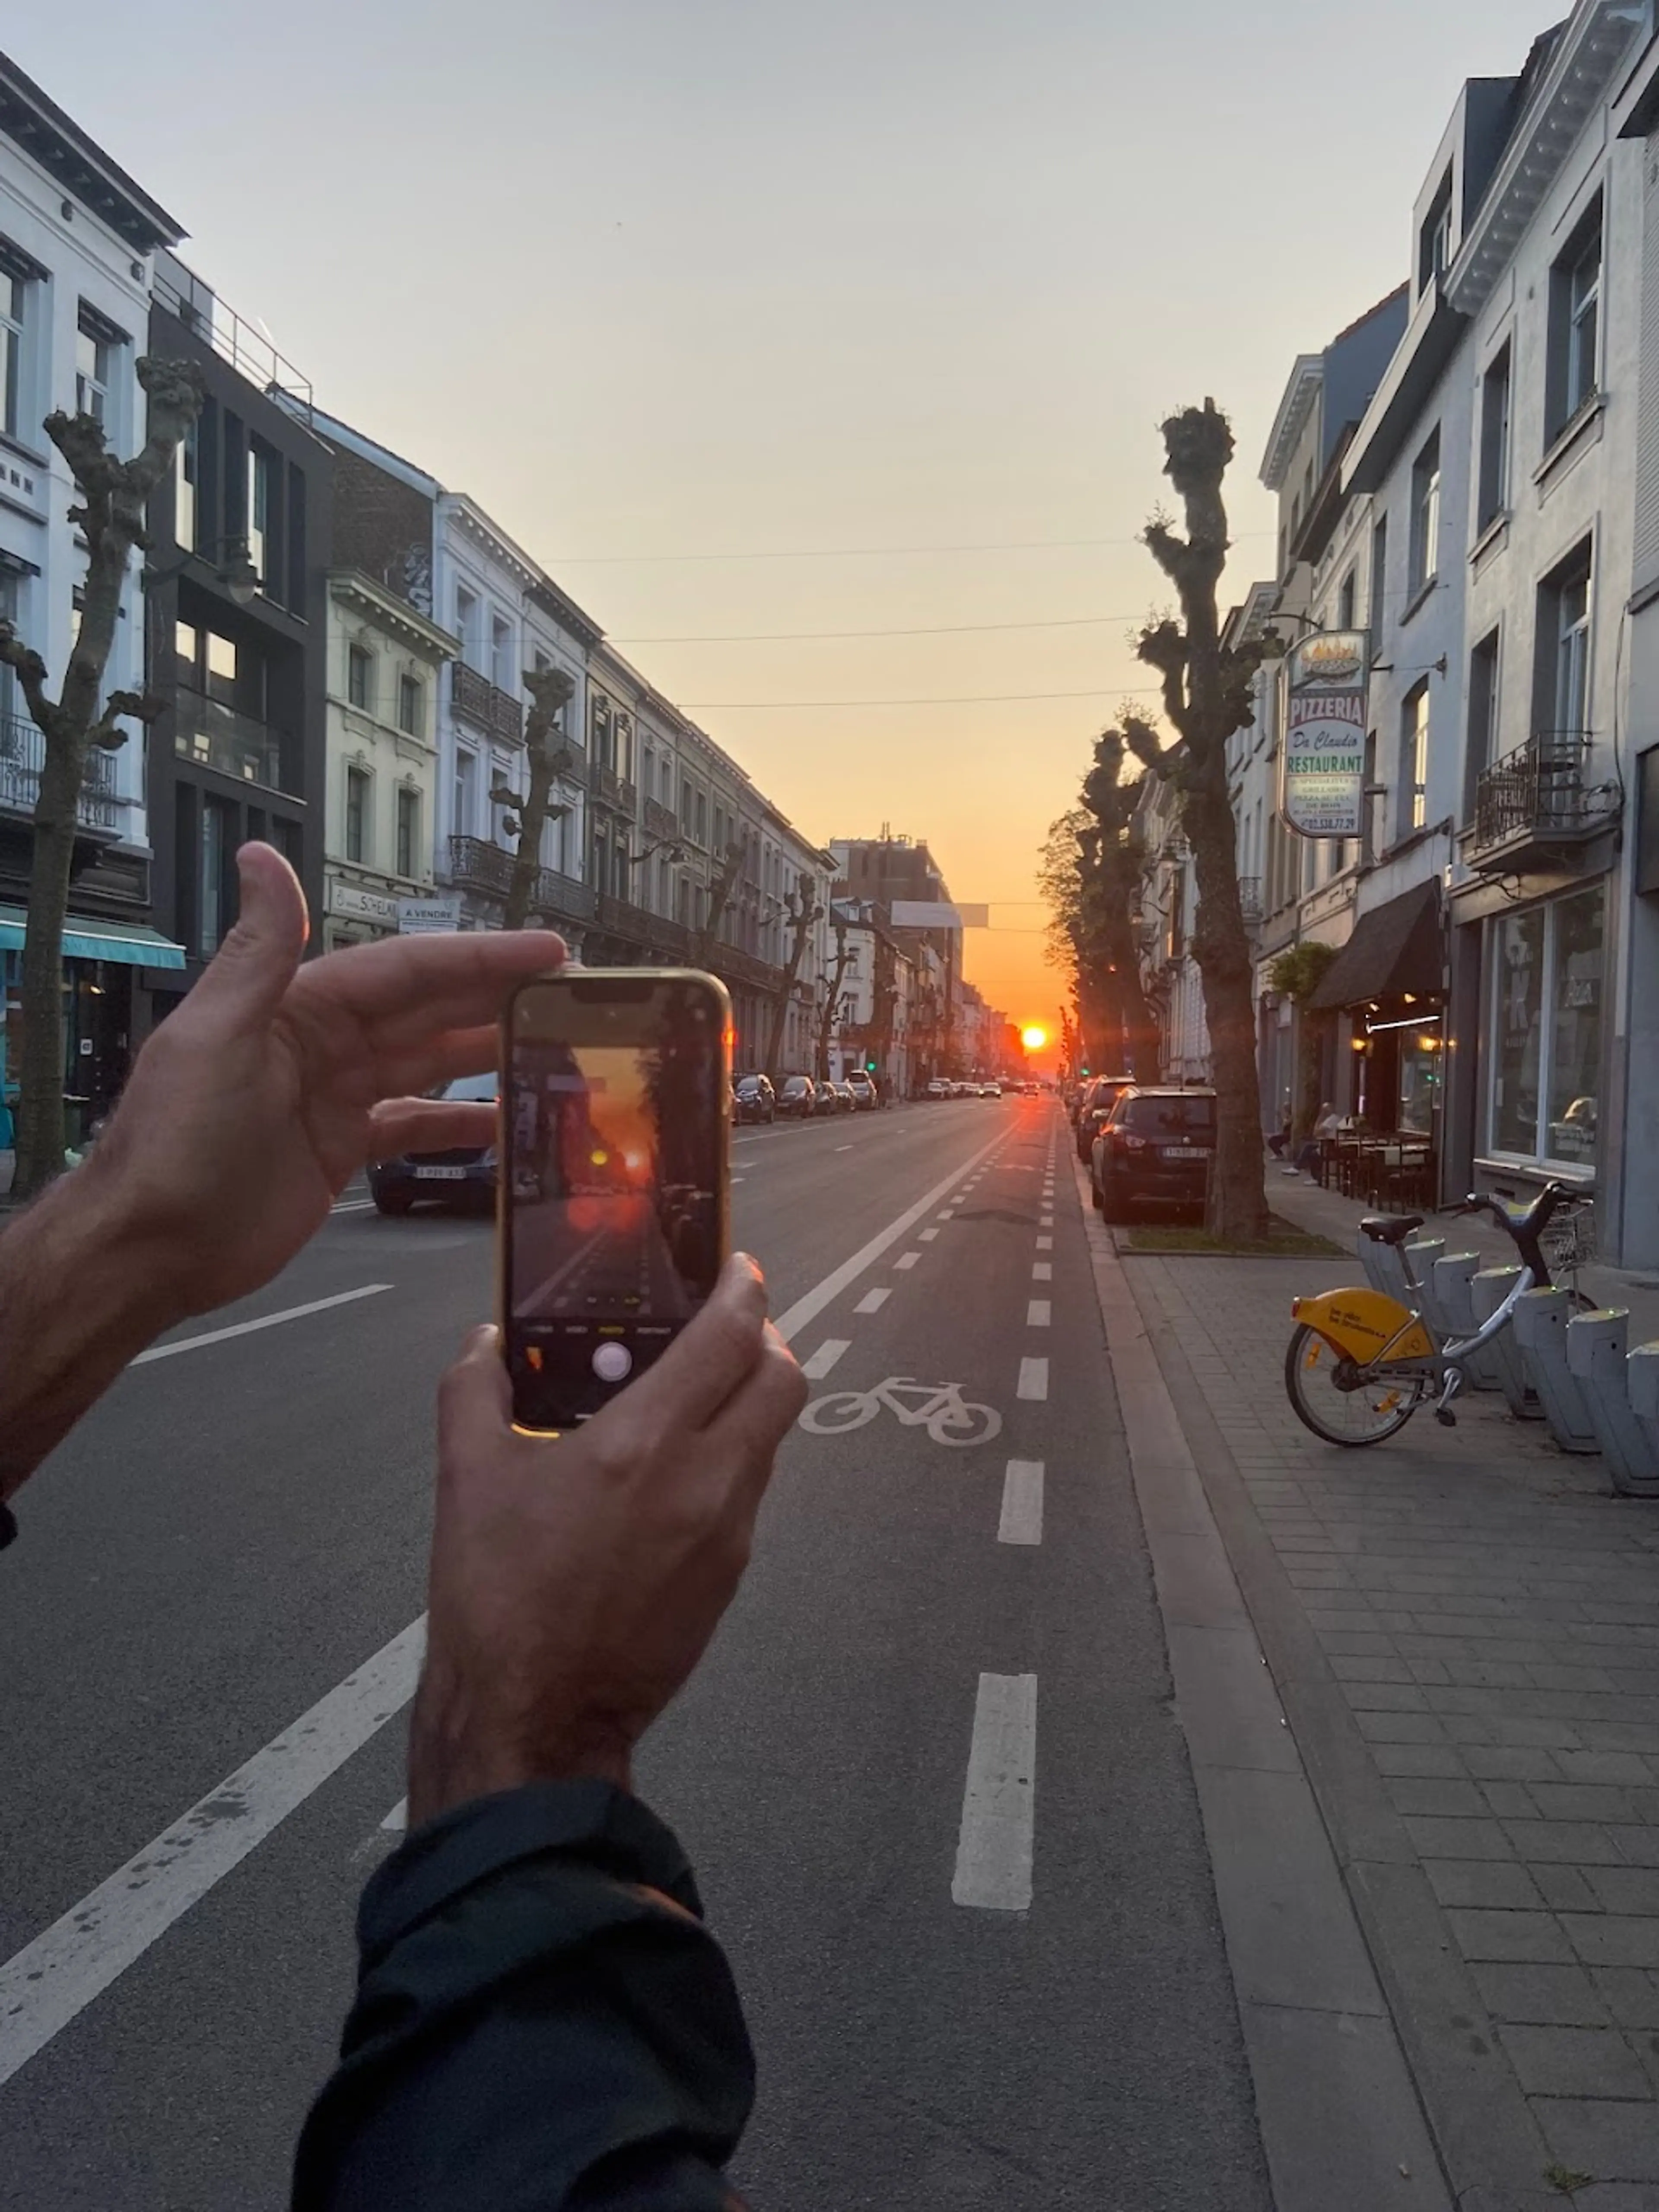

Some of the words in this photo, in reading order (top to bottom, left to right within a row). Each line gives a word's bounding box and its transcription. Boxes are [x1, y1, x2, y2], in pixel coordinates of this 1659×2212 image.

[1290, 697, 1362, 726] PIZZERIA
[1293, 731, 1309, 748] Da
[1314, 731, 1357, 751] Claudio
[1288, 756, 1362, 773] RESTAURANT
[415, 910, 452, 919] VENDRE
